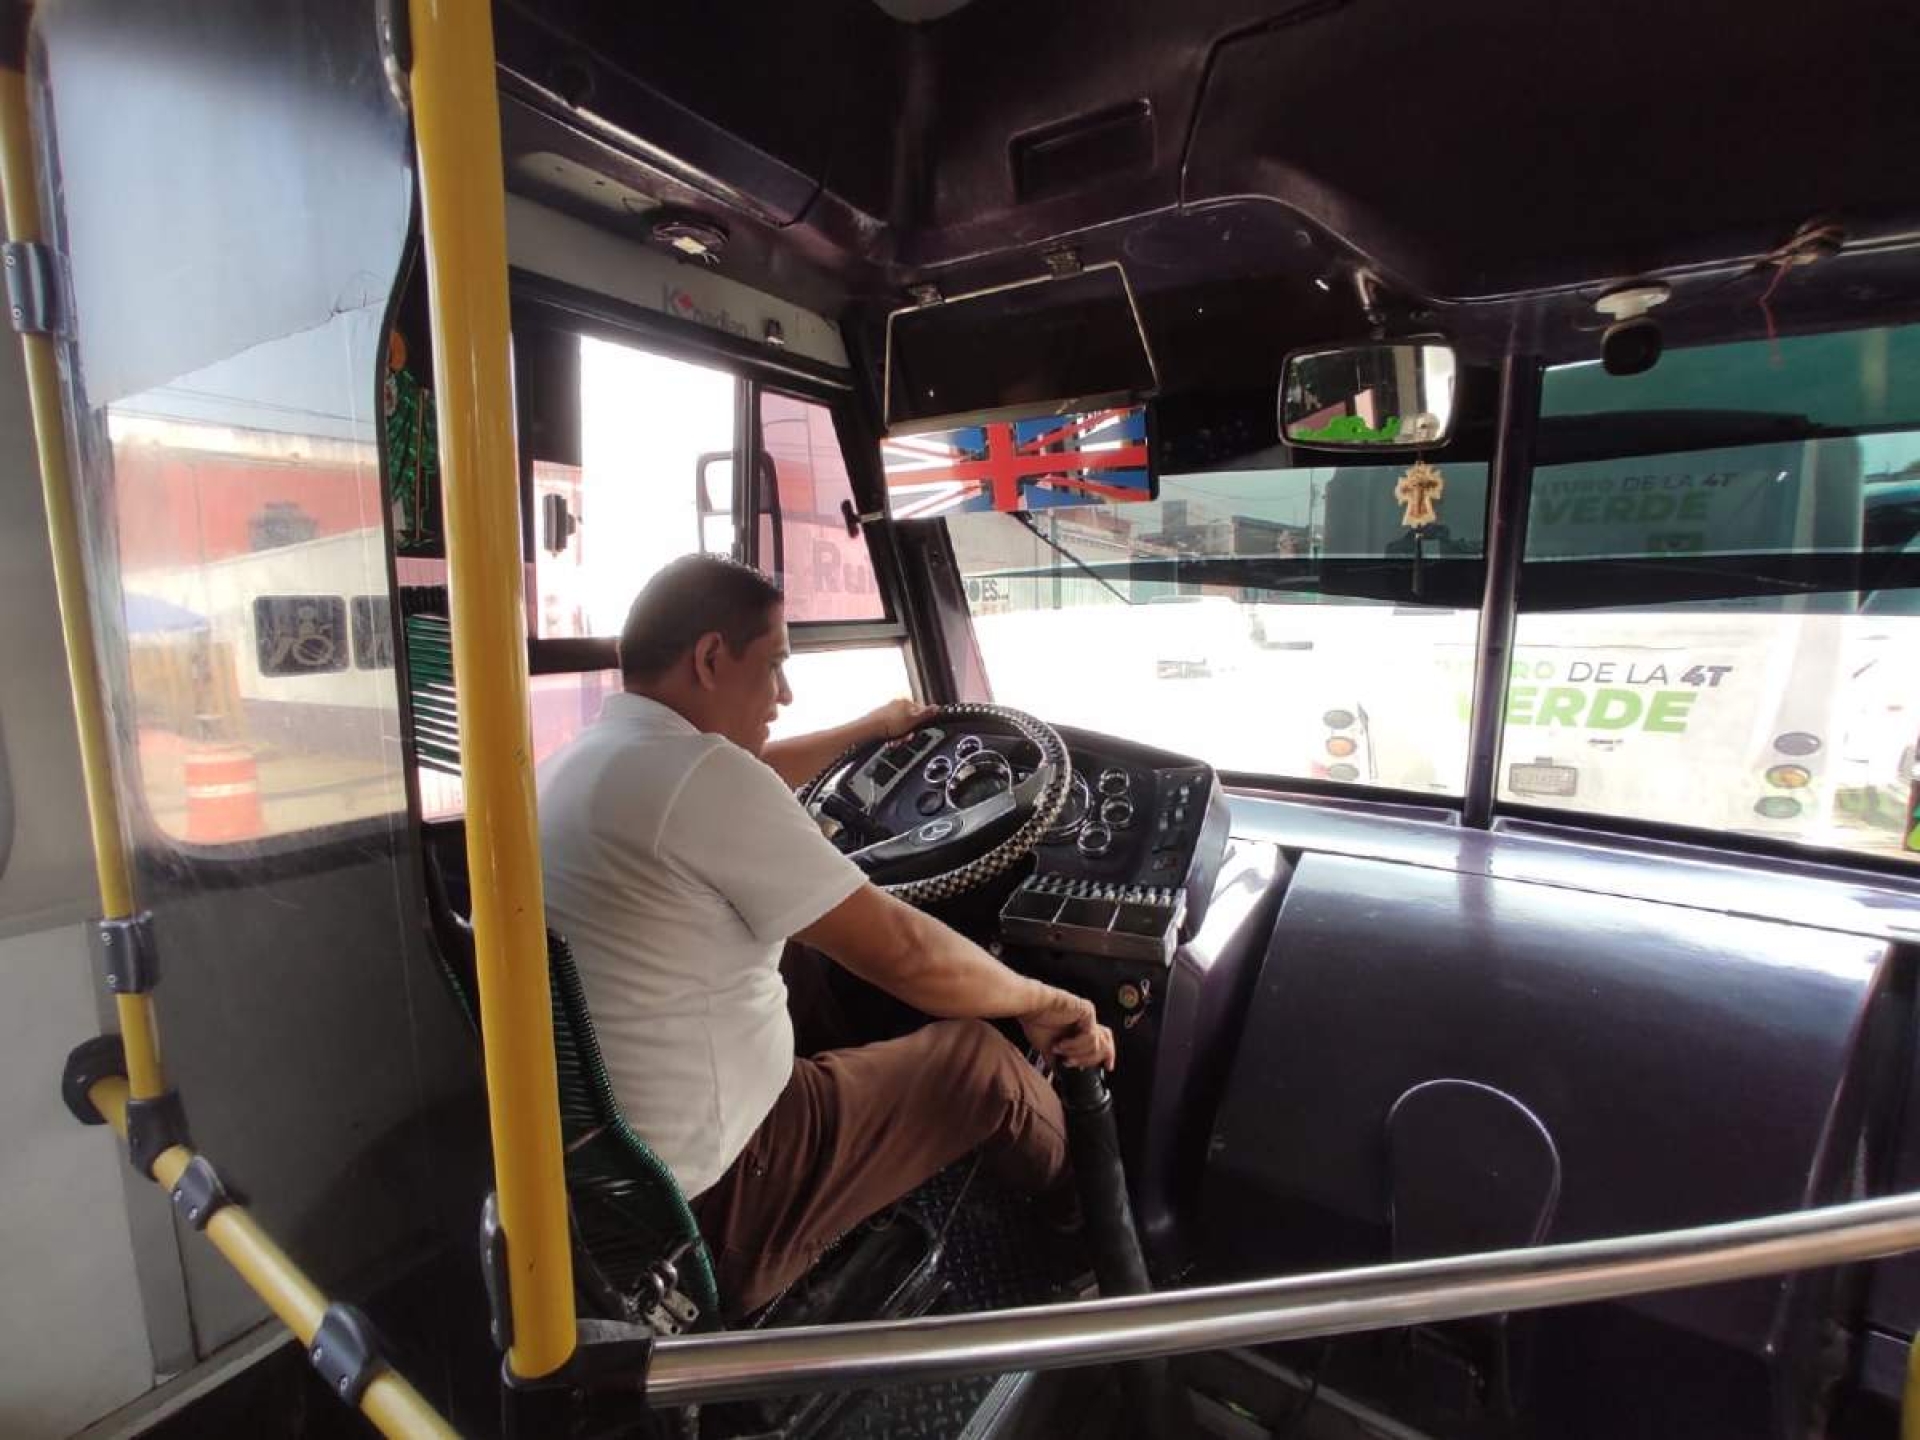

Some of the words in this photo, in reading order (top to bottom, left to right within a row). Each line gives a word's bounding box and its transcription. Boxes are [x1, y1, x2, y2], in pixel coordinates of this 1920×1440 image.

[1538, 491, 1713, 524] VERDE
[1567, 661, 1616, 684] DE
[1626, 662, 1668, 685] LA
[1680, 664, 1733, 688] 4T
